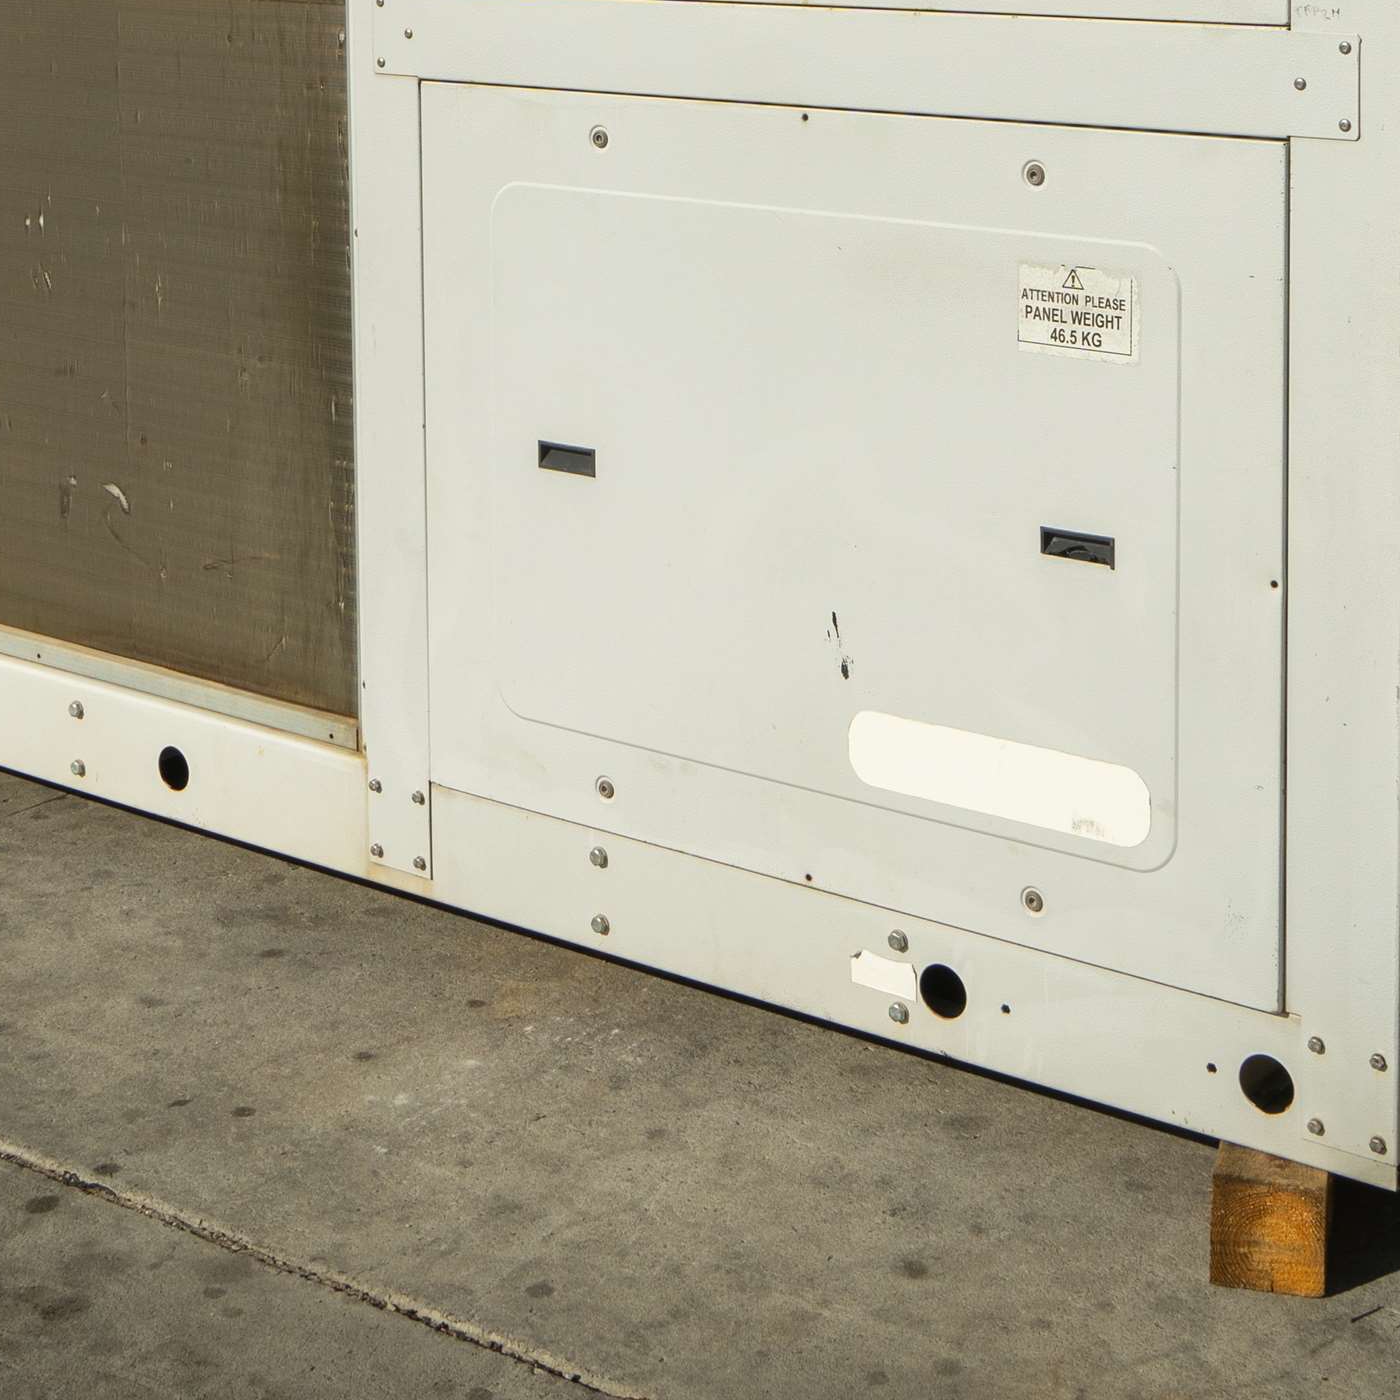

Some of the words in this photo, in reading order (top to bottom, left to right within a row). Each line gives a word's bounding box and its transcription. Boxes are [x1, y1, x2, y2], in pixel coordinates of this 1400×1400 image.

[1021, 288, 1080, 306] ATTENTION
[1084, 295, 1126, 312] PLEASE
[1025, 304, 1068, 324] PANEL
[1070, 310, 1123, 331] WEIGHT
[1050, 328, 1078, 345] 46.5
[1081, 331, 1103, 348] KG
